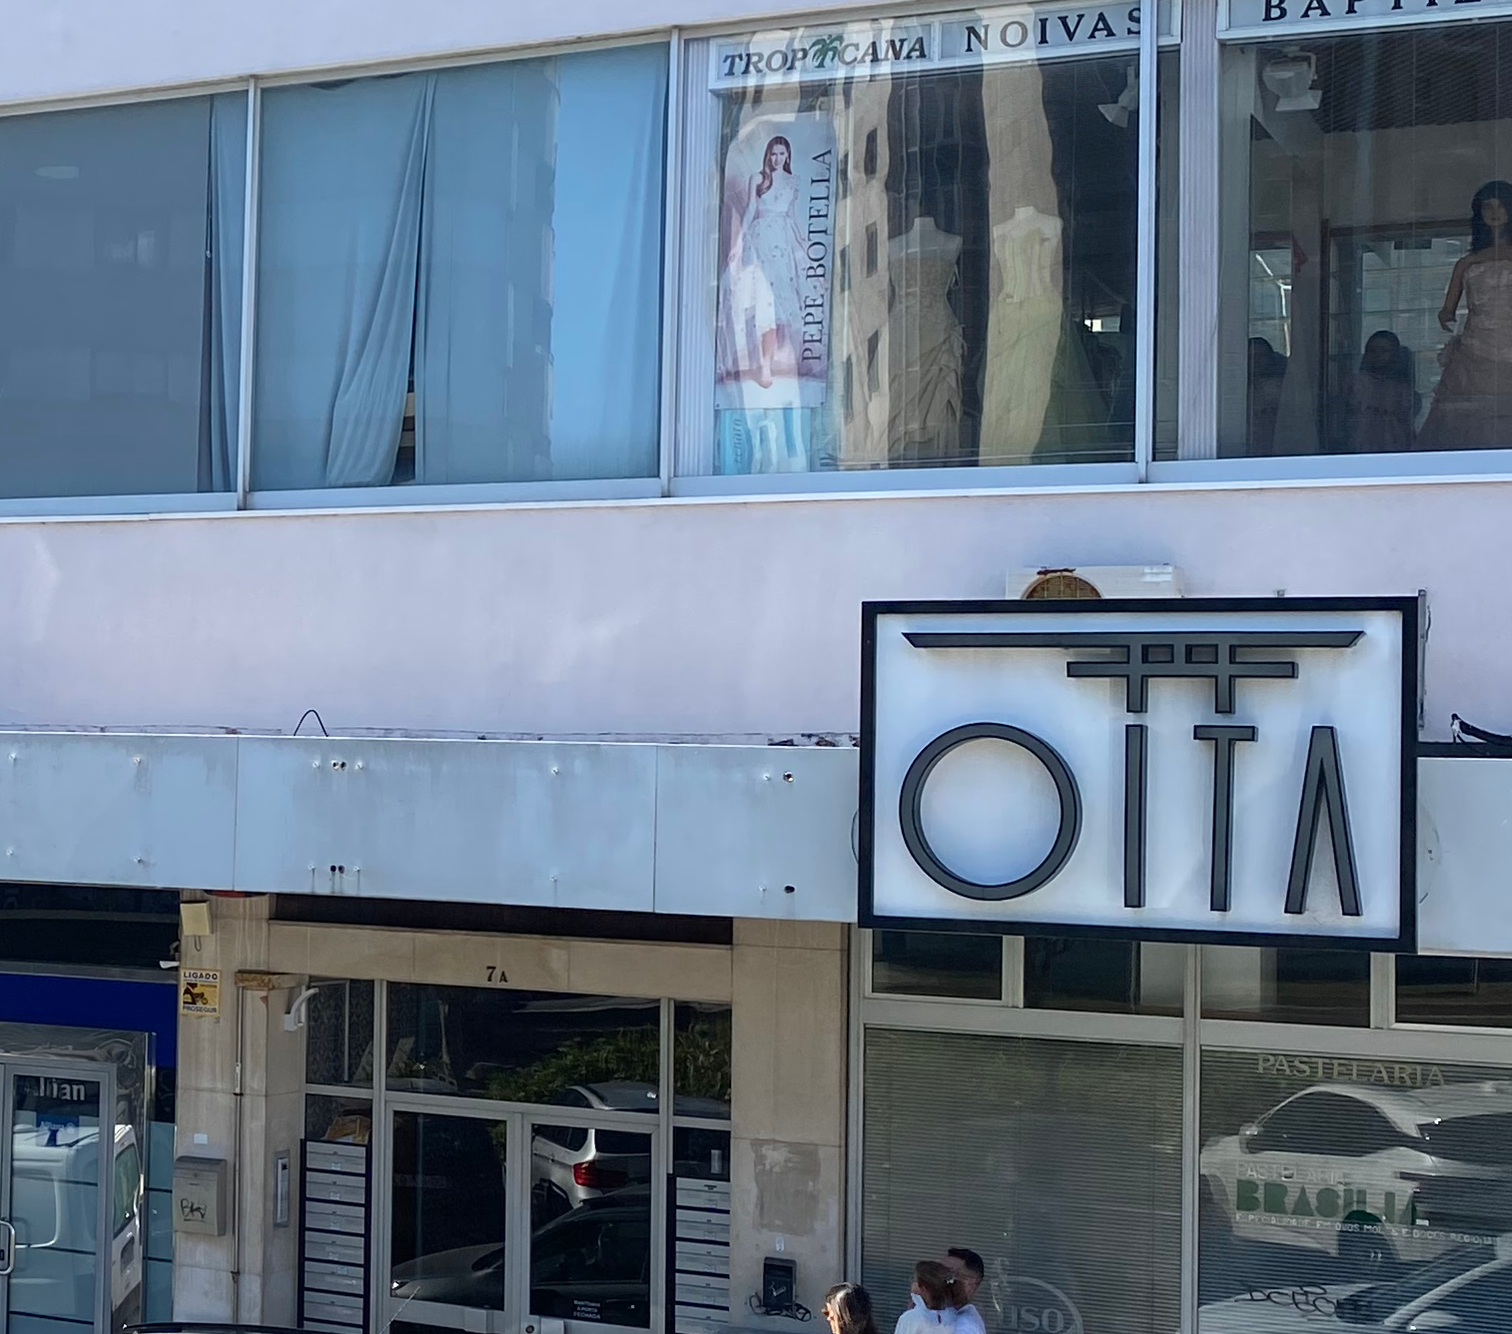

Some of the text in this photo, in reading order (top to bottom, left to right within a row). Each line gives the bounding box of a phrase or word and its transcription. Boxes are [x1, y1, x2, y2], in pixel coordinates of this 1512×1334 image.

[964, 7, 1141, 53] NOIVAS
[801, 148, 832, 363] PEPE BOTELLA
[183, 971, 218, 980] LIGADO
[1256, 1054, 1445, 1087] PASTELARIA
